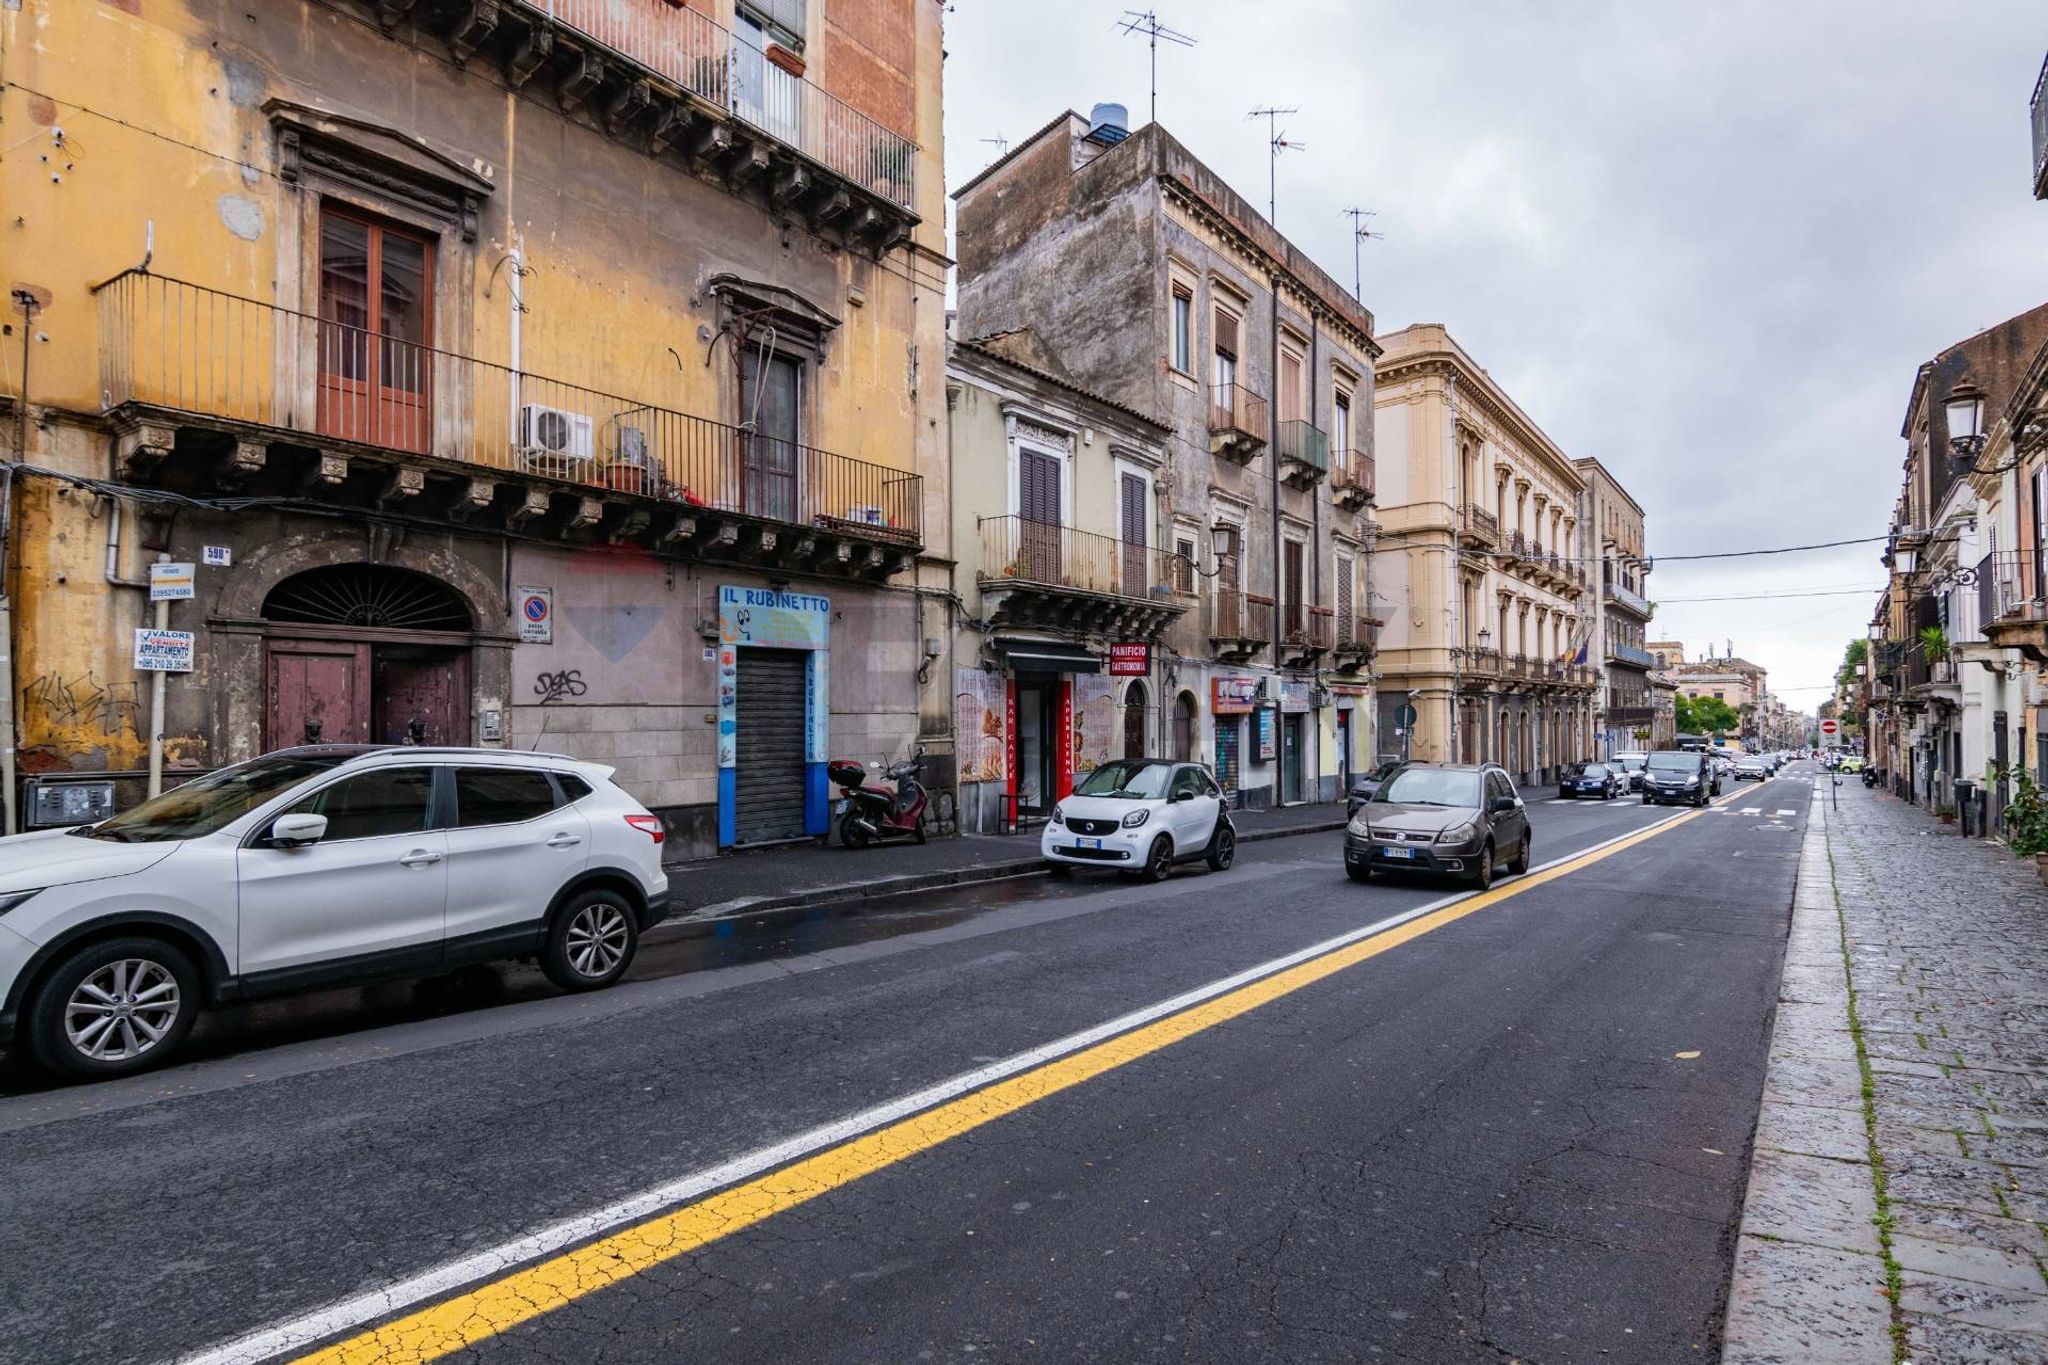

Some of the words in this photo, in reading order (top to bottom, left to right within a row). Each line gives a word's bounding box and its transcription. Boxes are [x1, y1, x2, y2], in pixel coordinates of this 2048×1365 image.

[724, 587, 739, 604] IL
[747, 590, 829, 612] RUBINETTO
[152, 631, 191, 640] VALORE
[140, 643, 189, 657] APPARTAMENTO
[1112, 646, 1146, 657] PANIFICIO
[1111, 661, 1146, 672] GASTRONOMIA
